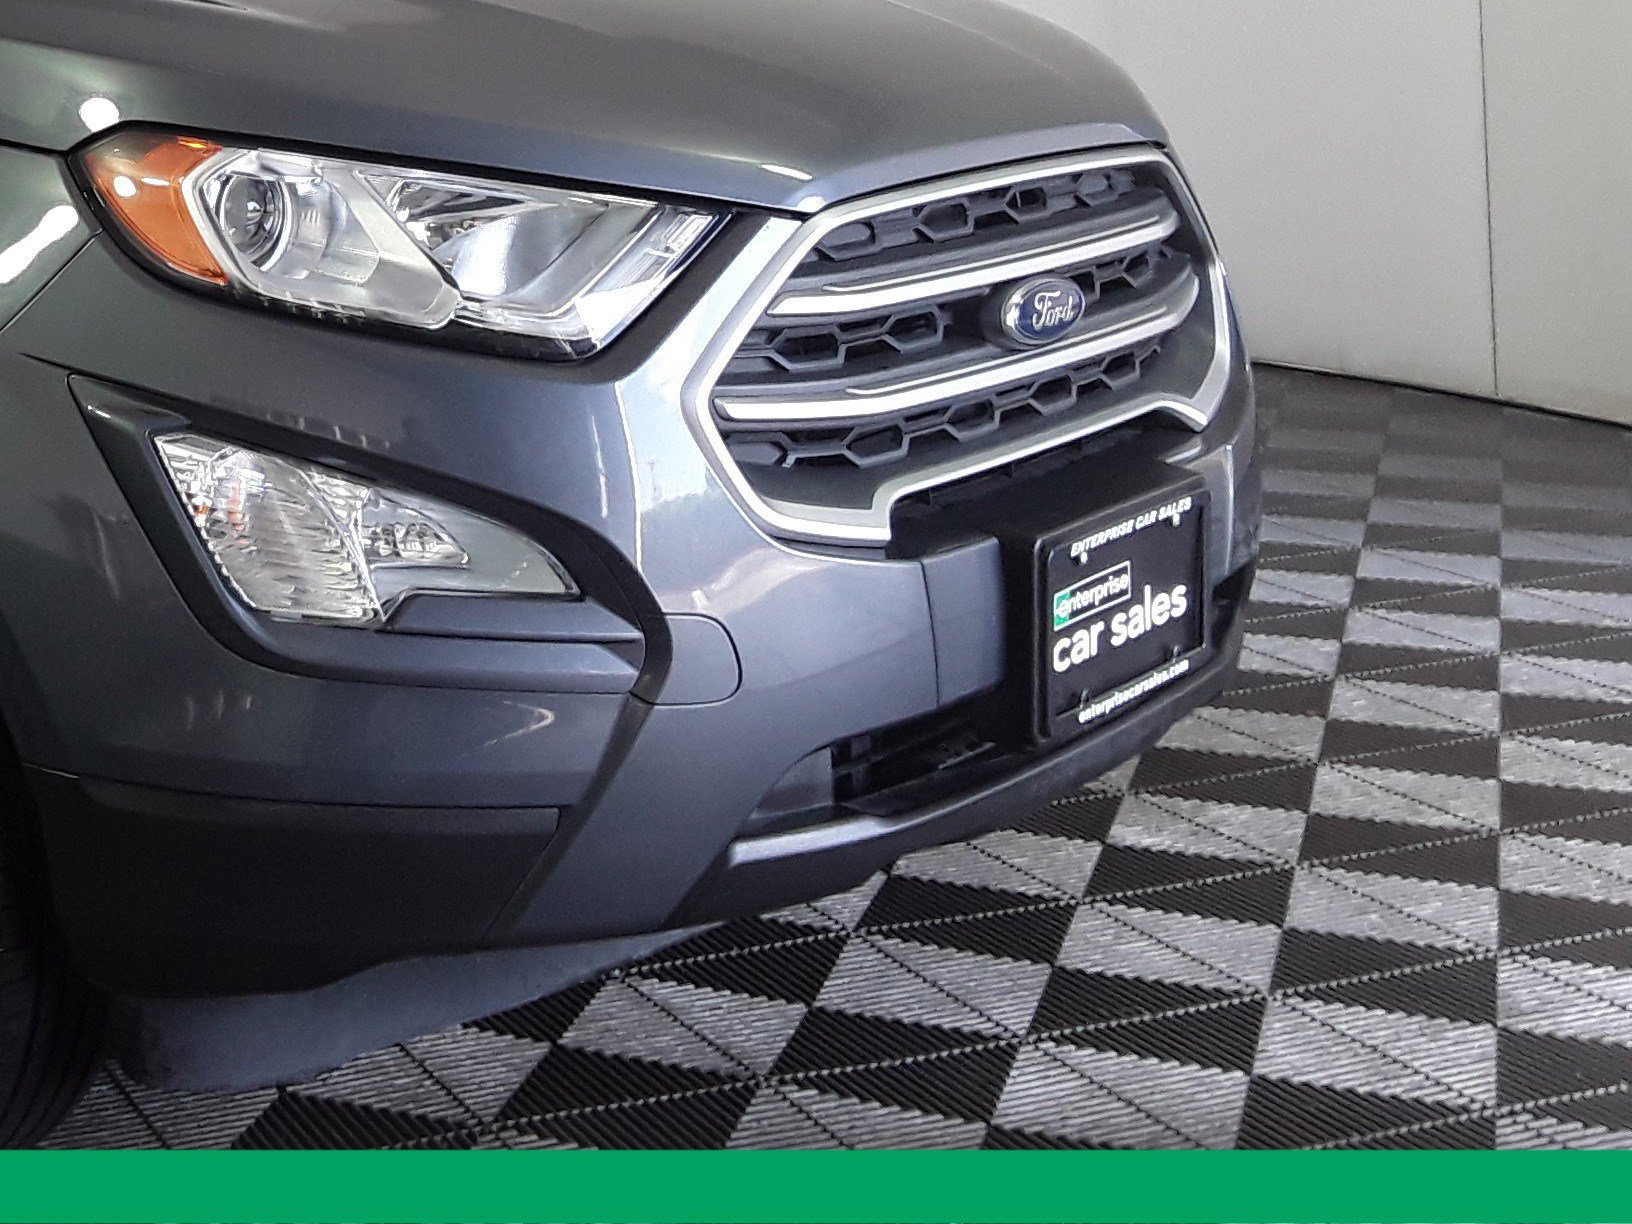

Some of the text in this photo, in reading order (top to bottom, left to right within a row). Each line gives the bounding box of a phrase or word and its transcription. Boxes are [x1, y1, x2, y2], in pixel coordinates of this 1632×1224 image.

[1032, 290, 1074, 332] Ford
[1070, 496, 1192, 558] ENTERPRISE CAR SALES
[1055, 574, 1129, 618] enterprise
[1053, 584, 1188, 673] car sales
